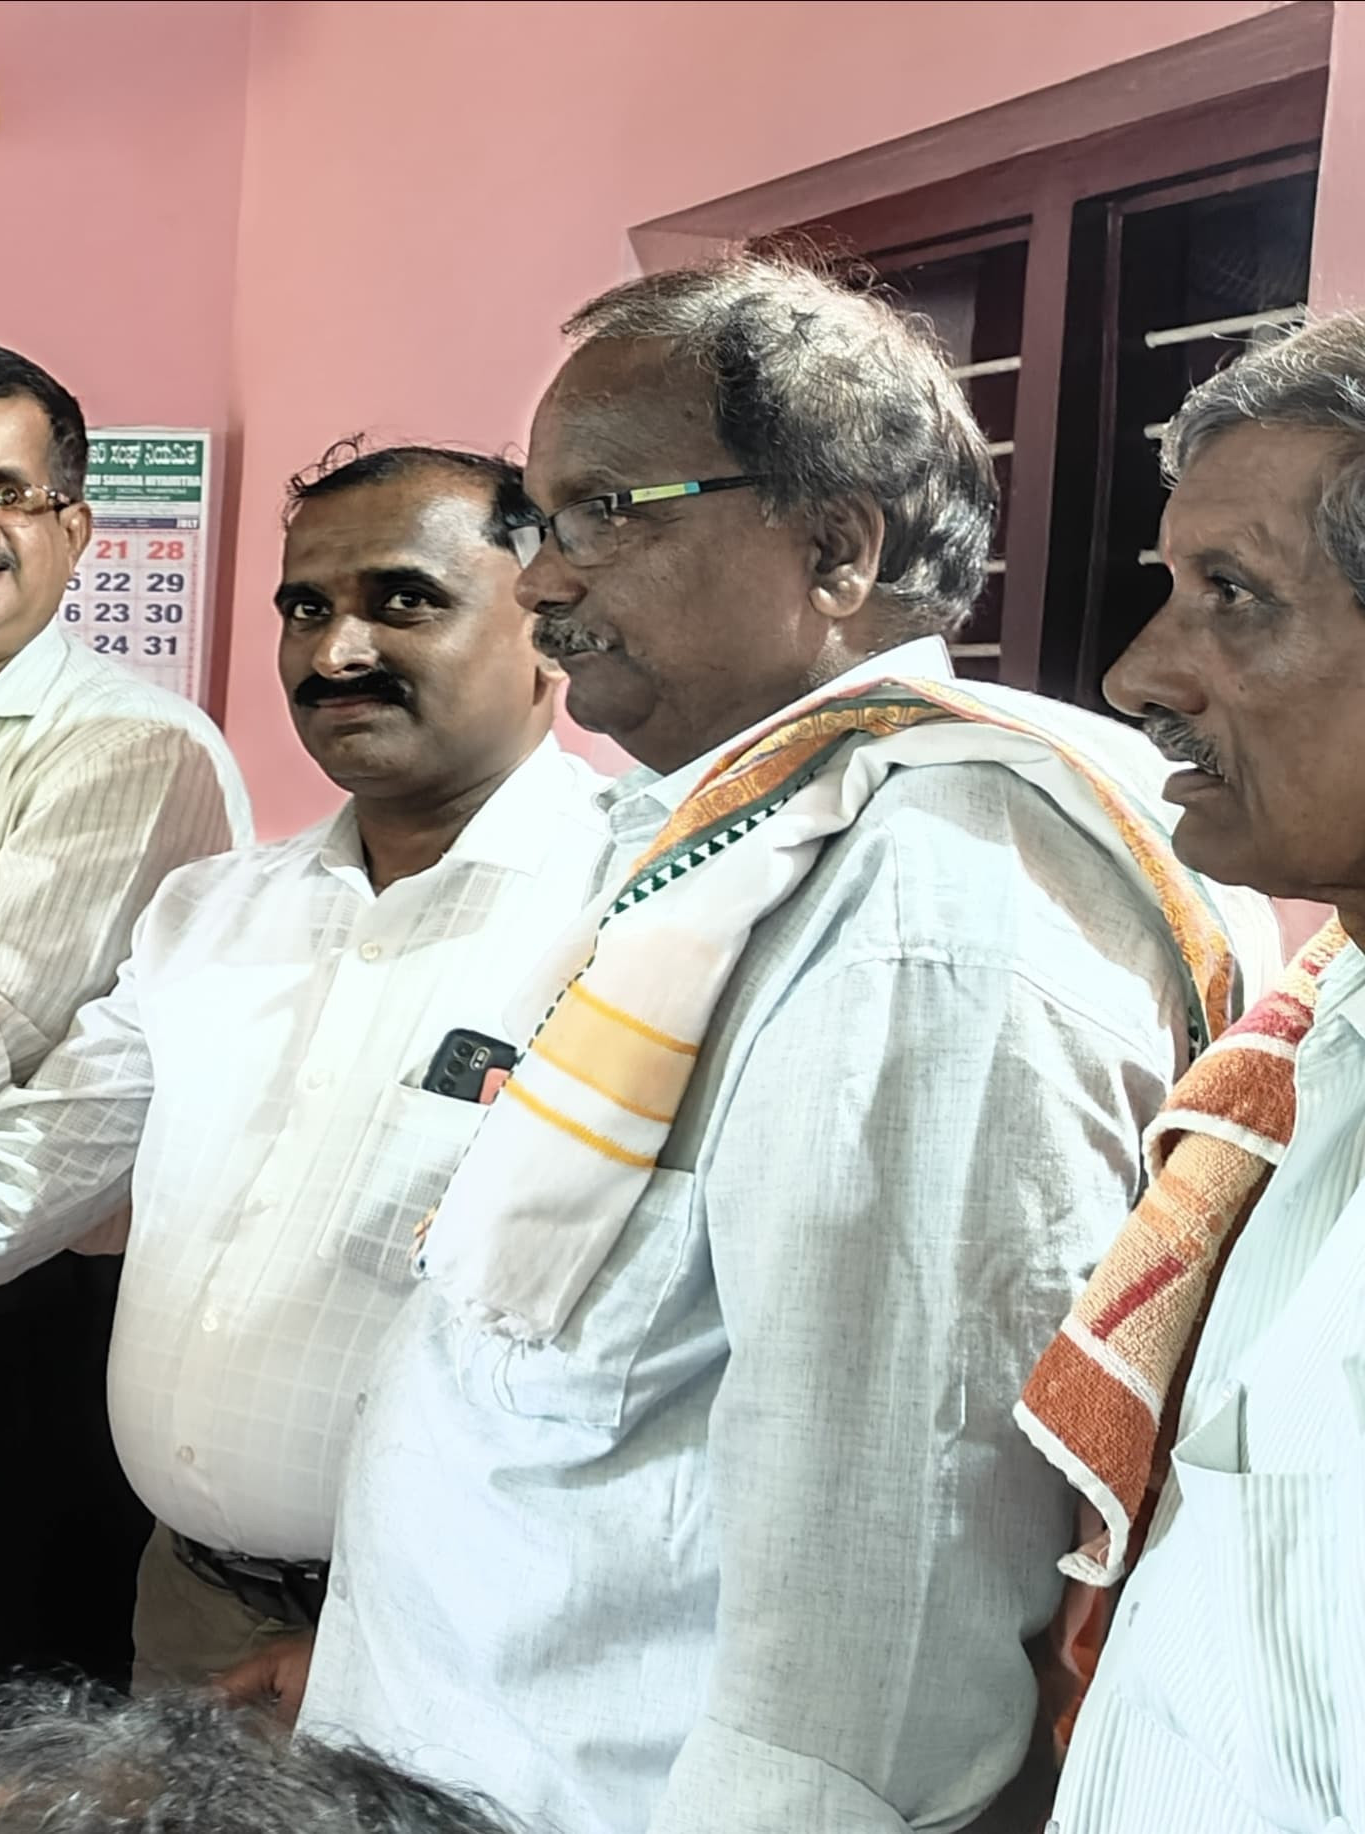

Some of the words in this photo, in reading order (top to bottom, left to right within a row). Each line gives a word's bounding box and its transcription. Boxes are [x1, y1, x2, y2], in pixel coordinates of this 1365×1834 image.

[95, 540, 130, 560] 21
[147, 541, 185, 561] 28
[94, 572, 131, 592] 22
[146, 573, 185, 593] 29
[94, 602, 131, 623] 23
[144, 603, 183, 624] 30
[93, 635, 130, 655] 24
[143, 636, 178, 656] 31
